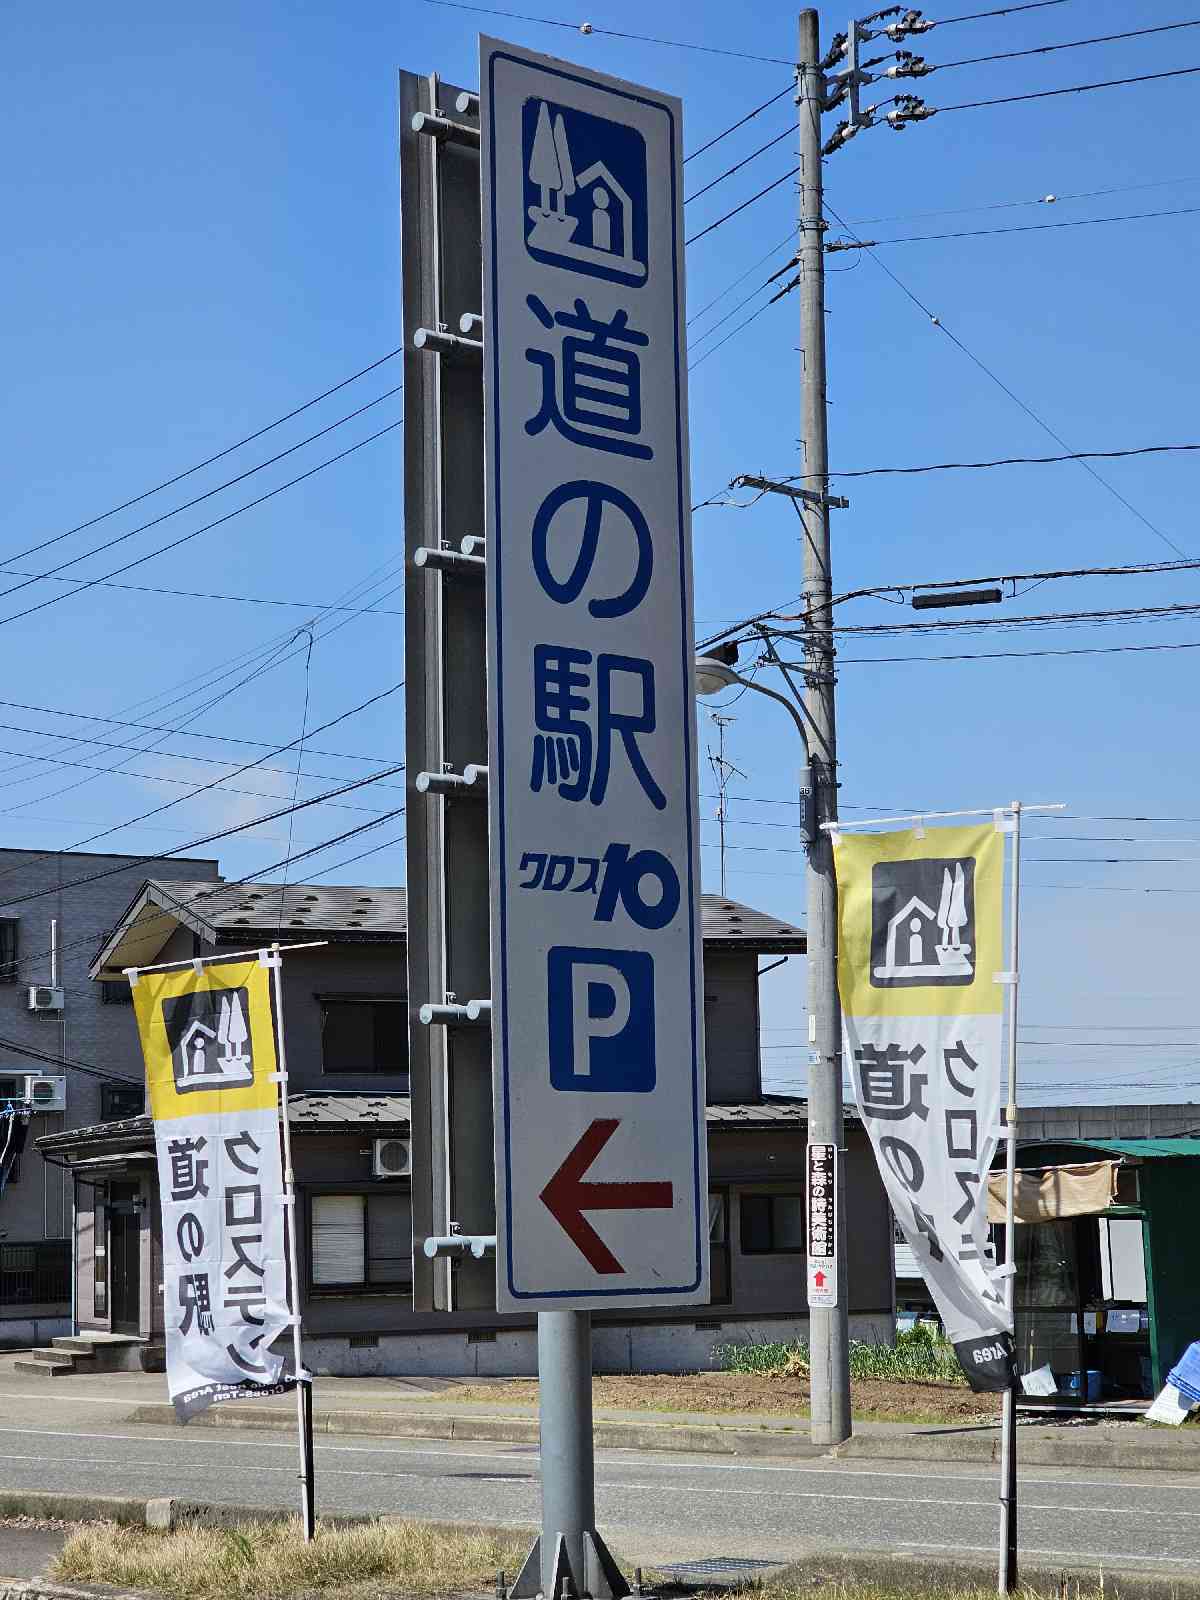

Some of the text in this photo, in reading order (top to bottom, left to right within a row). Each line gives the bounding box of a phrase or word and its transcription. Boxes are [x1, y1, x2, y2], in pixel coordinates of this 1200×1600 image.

[524, 293, 667, 810] 道の駅
[571, 962, 631, 1076] P
